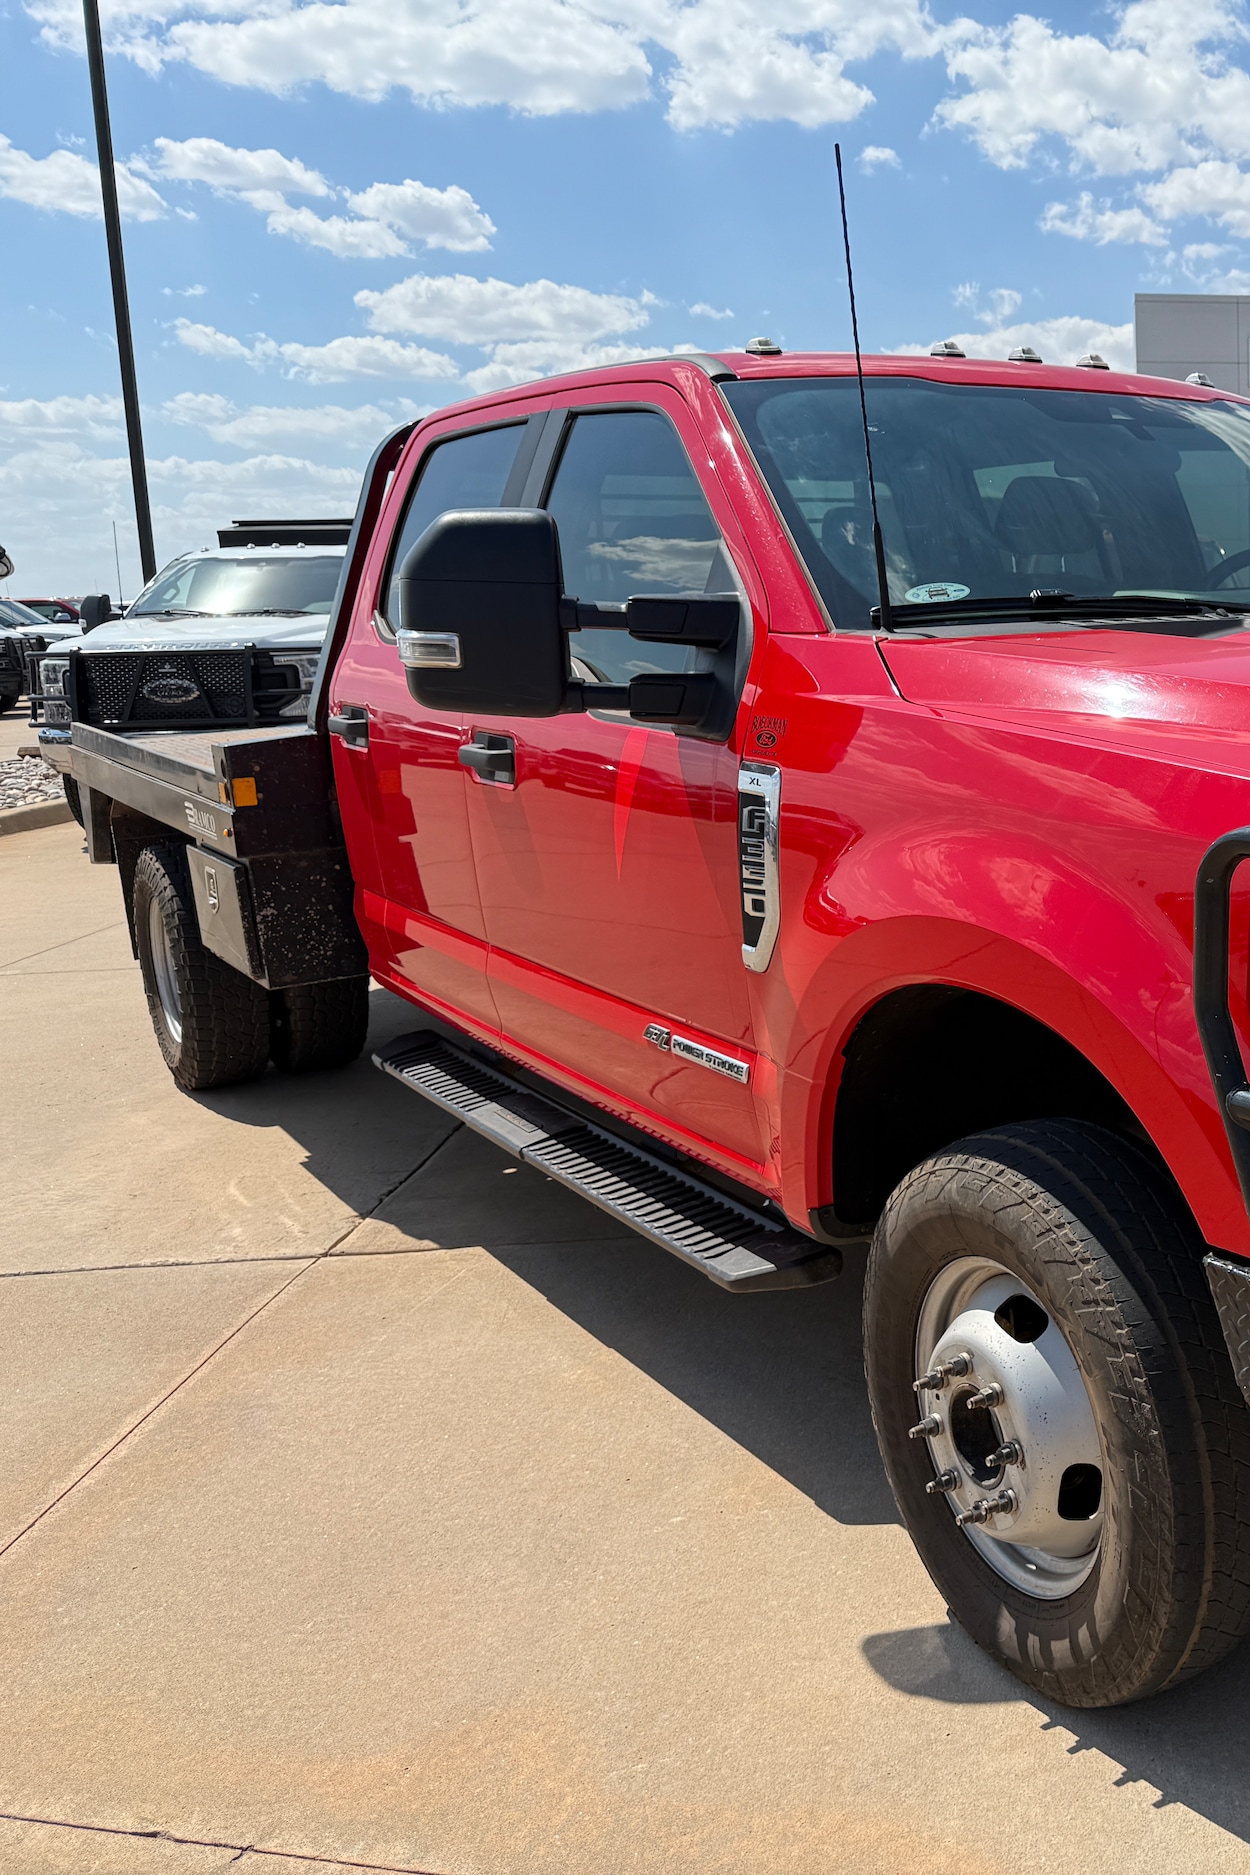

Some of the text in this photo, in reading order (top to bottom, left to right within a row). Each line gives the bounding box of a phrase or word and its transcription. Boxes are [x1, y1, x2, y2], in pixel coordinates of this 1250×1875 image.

[749, 777, 761, 787] XL
[184, 801, 216, 833] BRAMCO
[672, 1038, 704, 1061] POWER
[704, 1053, 745, 1077] STROKE
